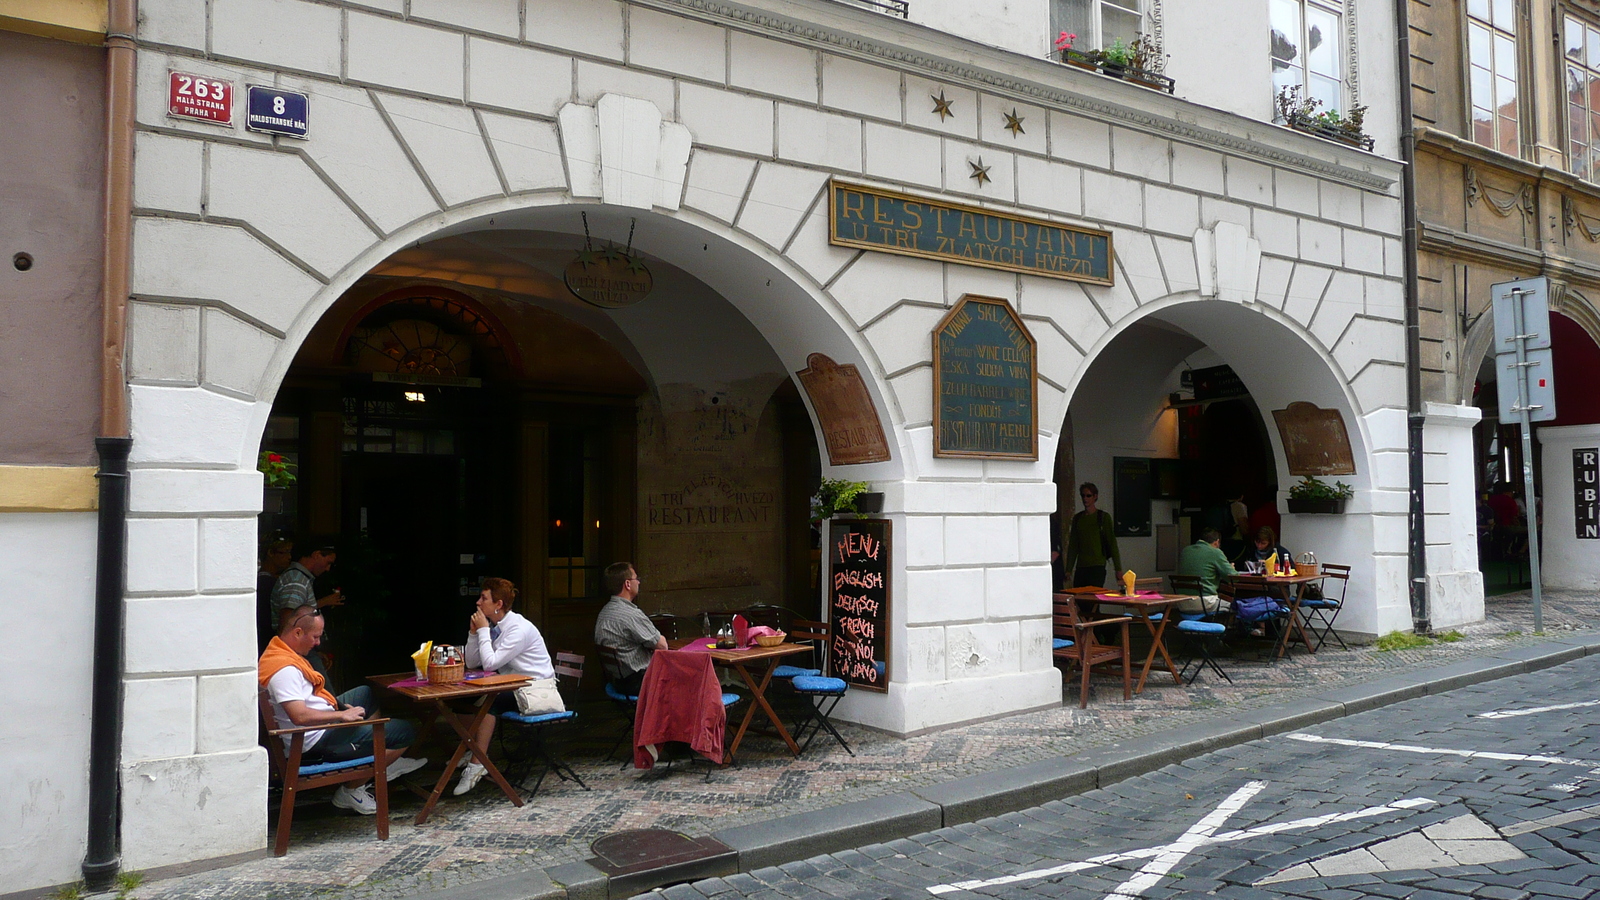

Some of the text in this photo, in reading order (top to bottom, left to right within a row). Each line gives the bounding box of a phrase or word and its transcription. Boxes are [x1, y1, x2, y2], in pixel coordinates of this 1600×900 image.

[178, 76, 225, 101] 263
[176, 96, 225, 111] MALÁ STRANA
[184, 106, 209, 117] PRAHA
[273, 96, 286, 115] 8
[250, 114, 294, 128] MALOSTRANSKÉ
[842, 190, 1101, 260] RESTAURANT
[852, 222, 869, 241] U
[936, 236, 1025, 267] ZLATÝCH
[976, 344, 1000, 361] WINE
[1002, 347, 1030, 363] CELLAR
[969, 403, 1003, 418] FONDUE
[999, 423, 1030, 438] MENU
[1583, 453, 1598, 538] RUBÍN
[649, 505, 771, 525] RESTAURANT
[838, 532, 880, 563] MENU
[835, 593, 879, 617] DEUTSCH
[839, 616, 875, 639] FRENCH
